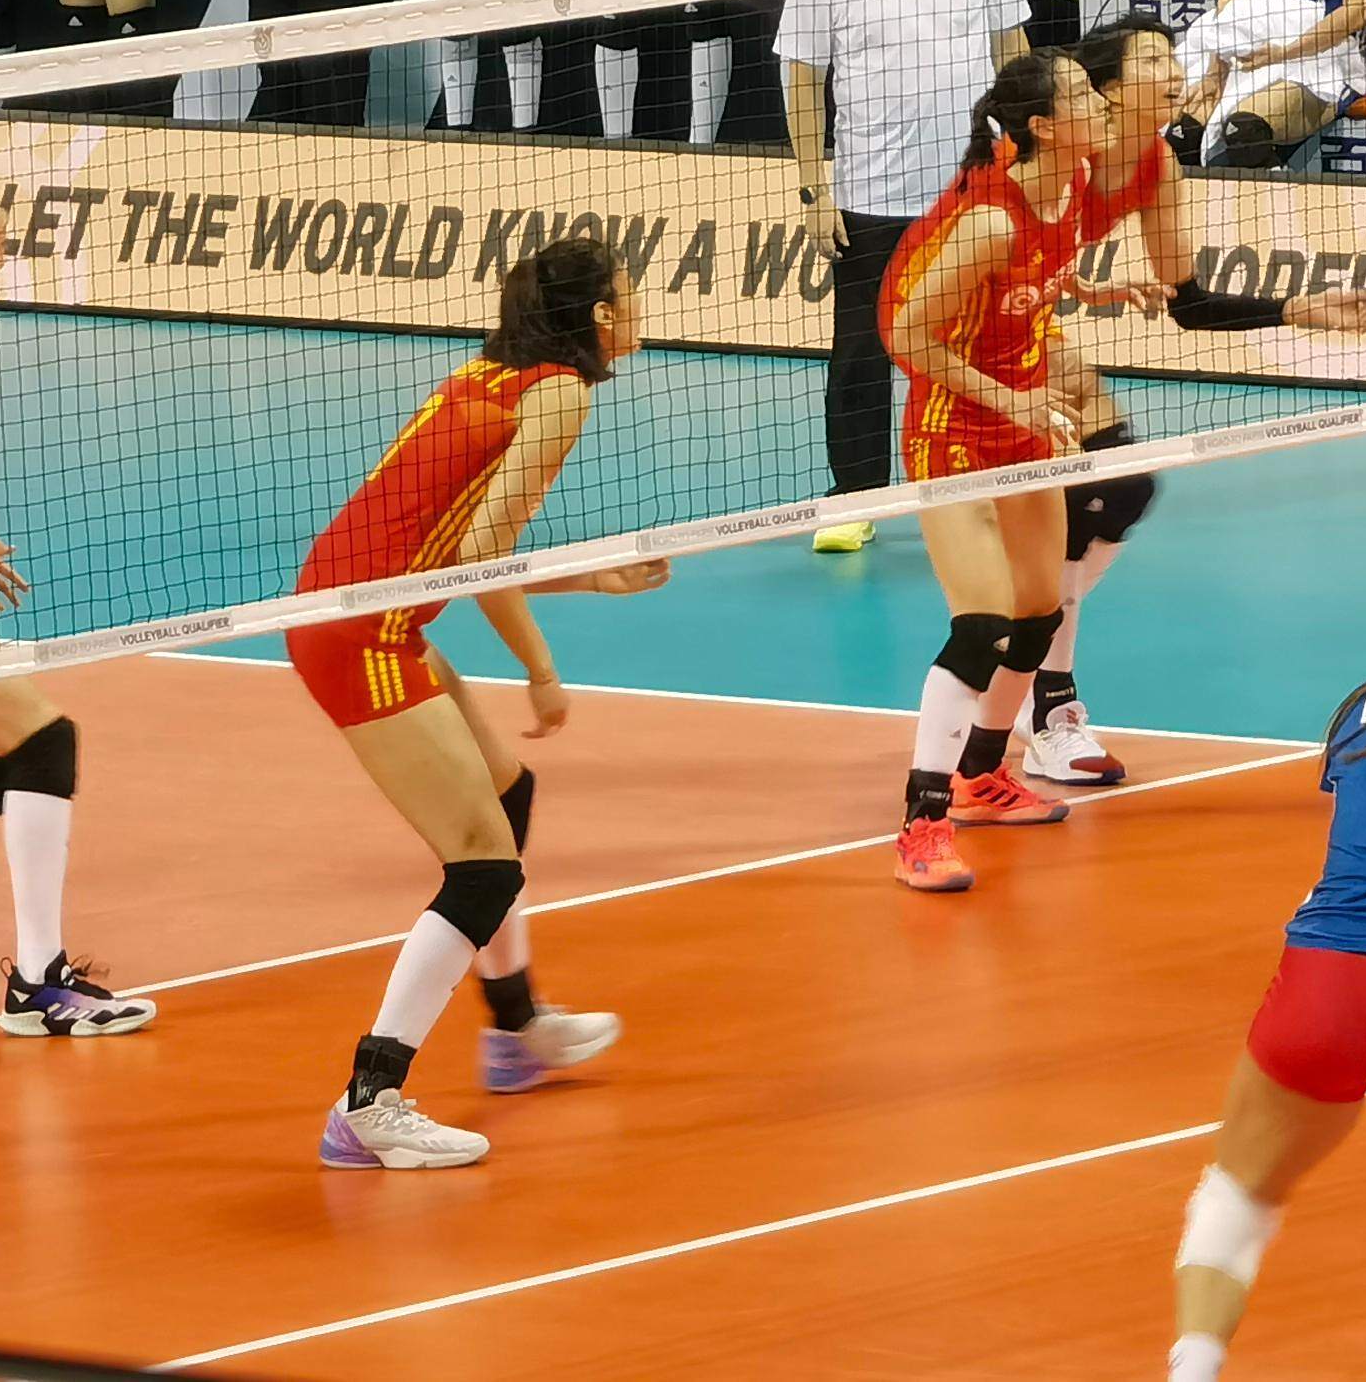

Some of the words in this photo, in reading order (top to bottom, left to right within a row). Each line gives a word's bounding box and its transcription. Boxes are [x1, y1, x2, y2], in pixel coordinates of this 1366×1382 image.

[117, 188, 240, 267] THE
[249, 195, 463, 281] WORLD
[667, 219, 718, 296] A
[1266, 419, 1317, 438] VOLLEYBALL
[1318, 412, 1360, 430] QUALIFIER
[995, 468, 1050, 486] VOLLEYBALL
[1050, 460, 1093, 477] QUALIFIER
[715, 516, 772, 536] VOLLEYBALL
[773, 507, 818, 525] QUALIFIER
[423, 571, 481, 592] VOLLEYBALL
[482, 561, 529, 581] QUALIFIER
[120, 625, 181, 646] VOLLEYBALL
[182, 616, 230, 635] QUALIFIER
